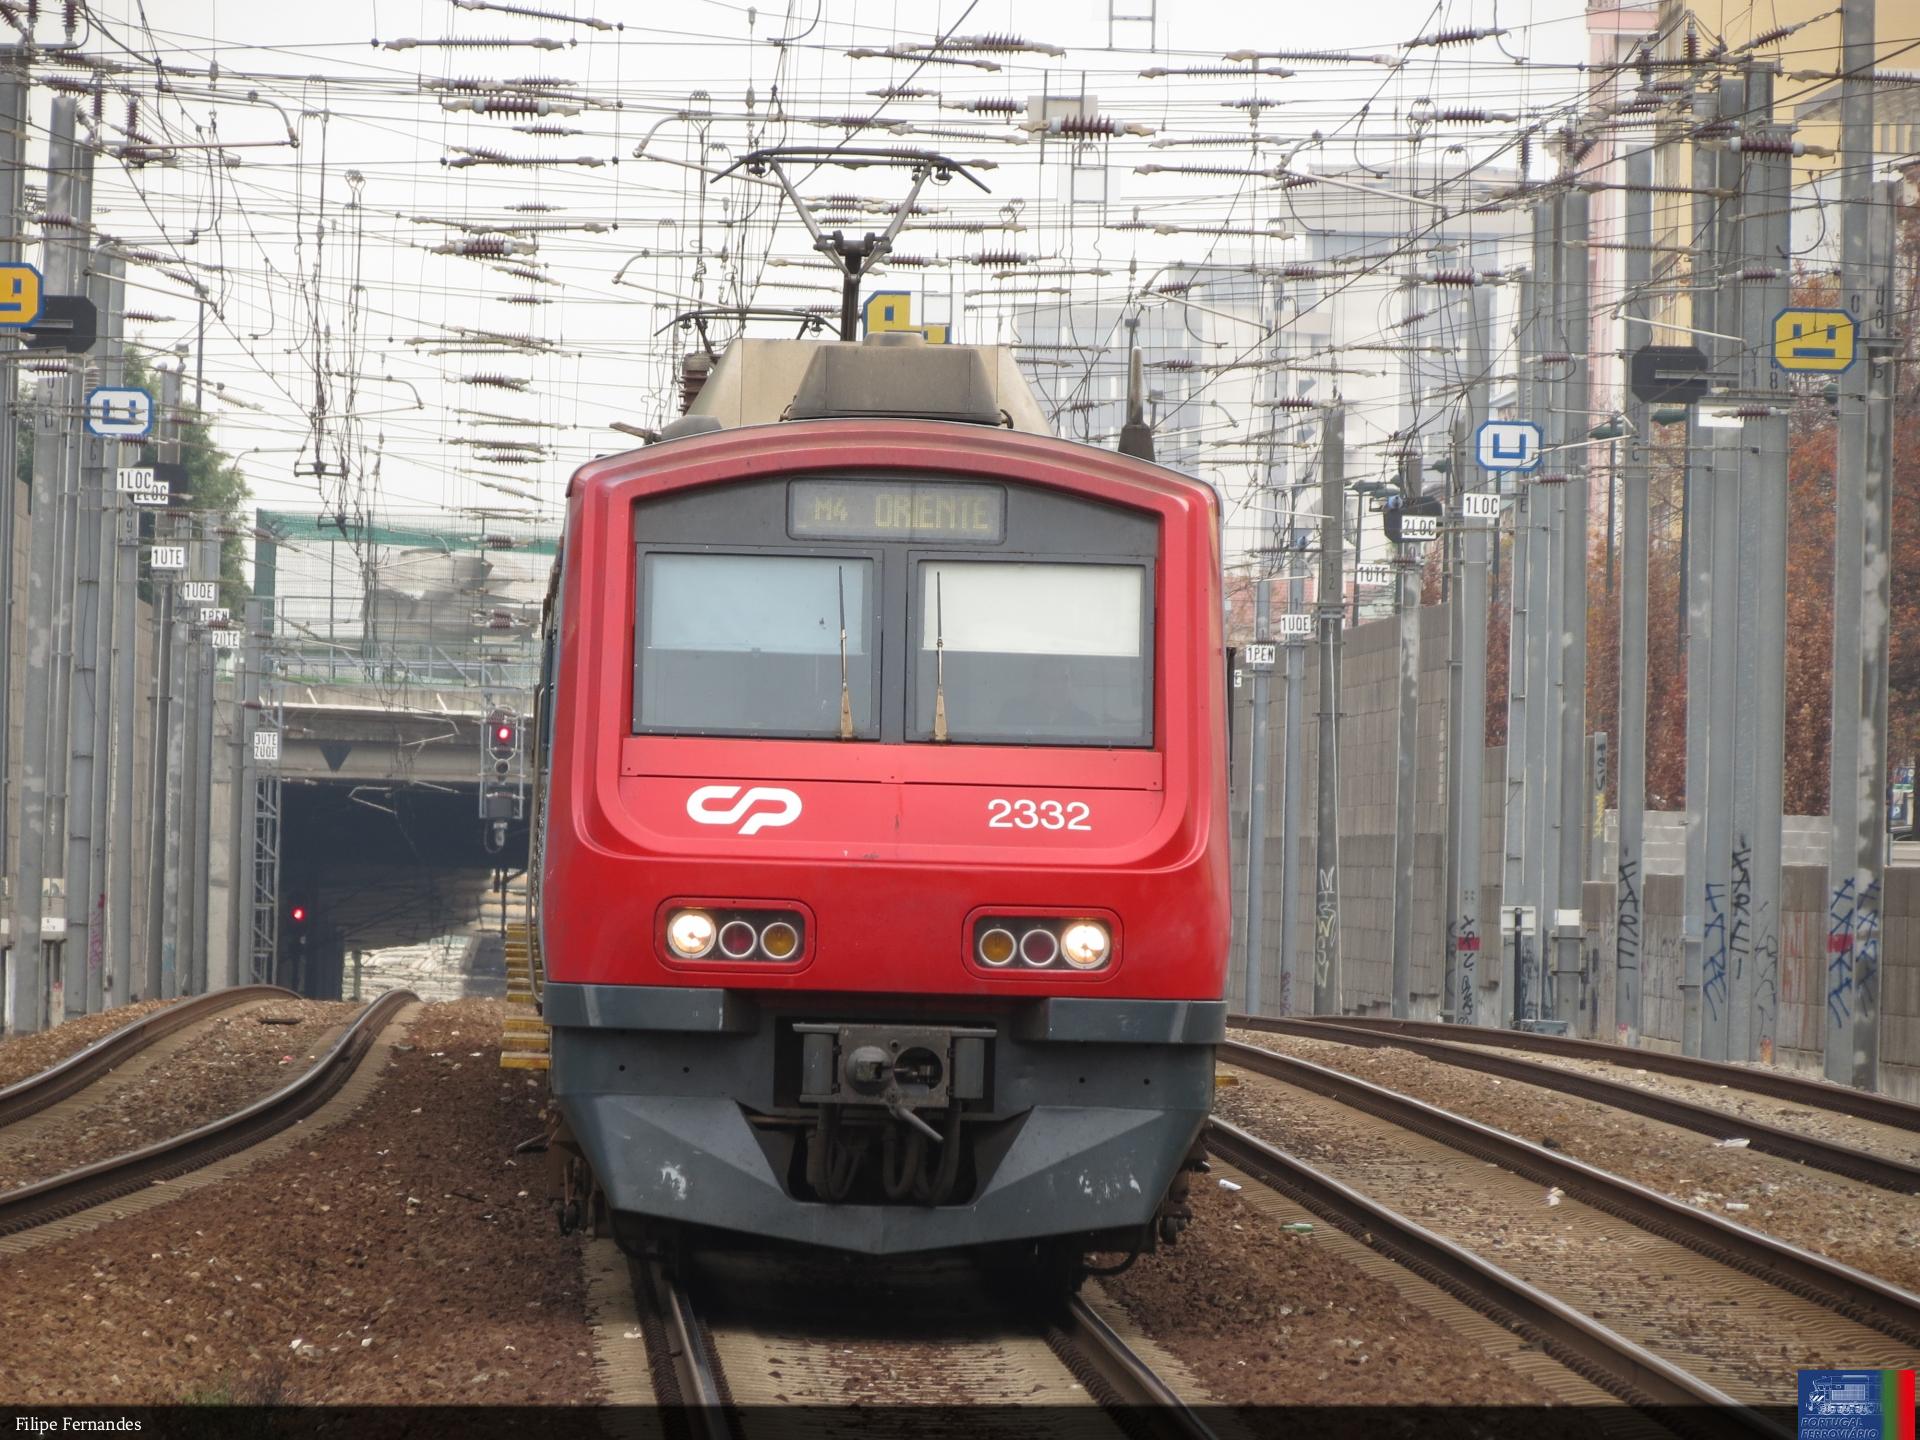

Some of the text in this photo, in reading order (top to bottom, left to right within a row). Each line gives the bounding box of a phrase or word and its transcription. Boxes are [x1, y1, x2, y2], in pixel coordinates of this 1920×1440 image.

[119, 471, 151, 489] 1LOC
[873, 493, 990, 530] ORIENTE
[1465, 497, 1498, 515] 1LOC
[1404, 519, 1435, 536] 2LOC
[153, 549, 182, 565] 1UTE
[1358, 565, 1389, 583] 1UTE
[1247, 646, 1274, 662] 1PEN
[987, 798, 1092, 832] 2332
